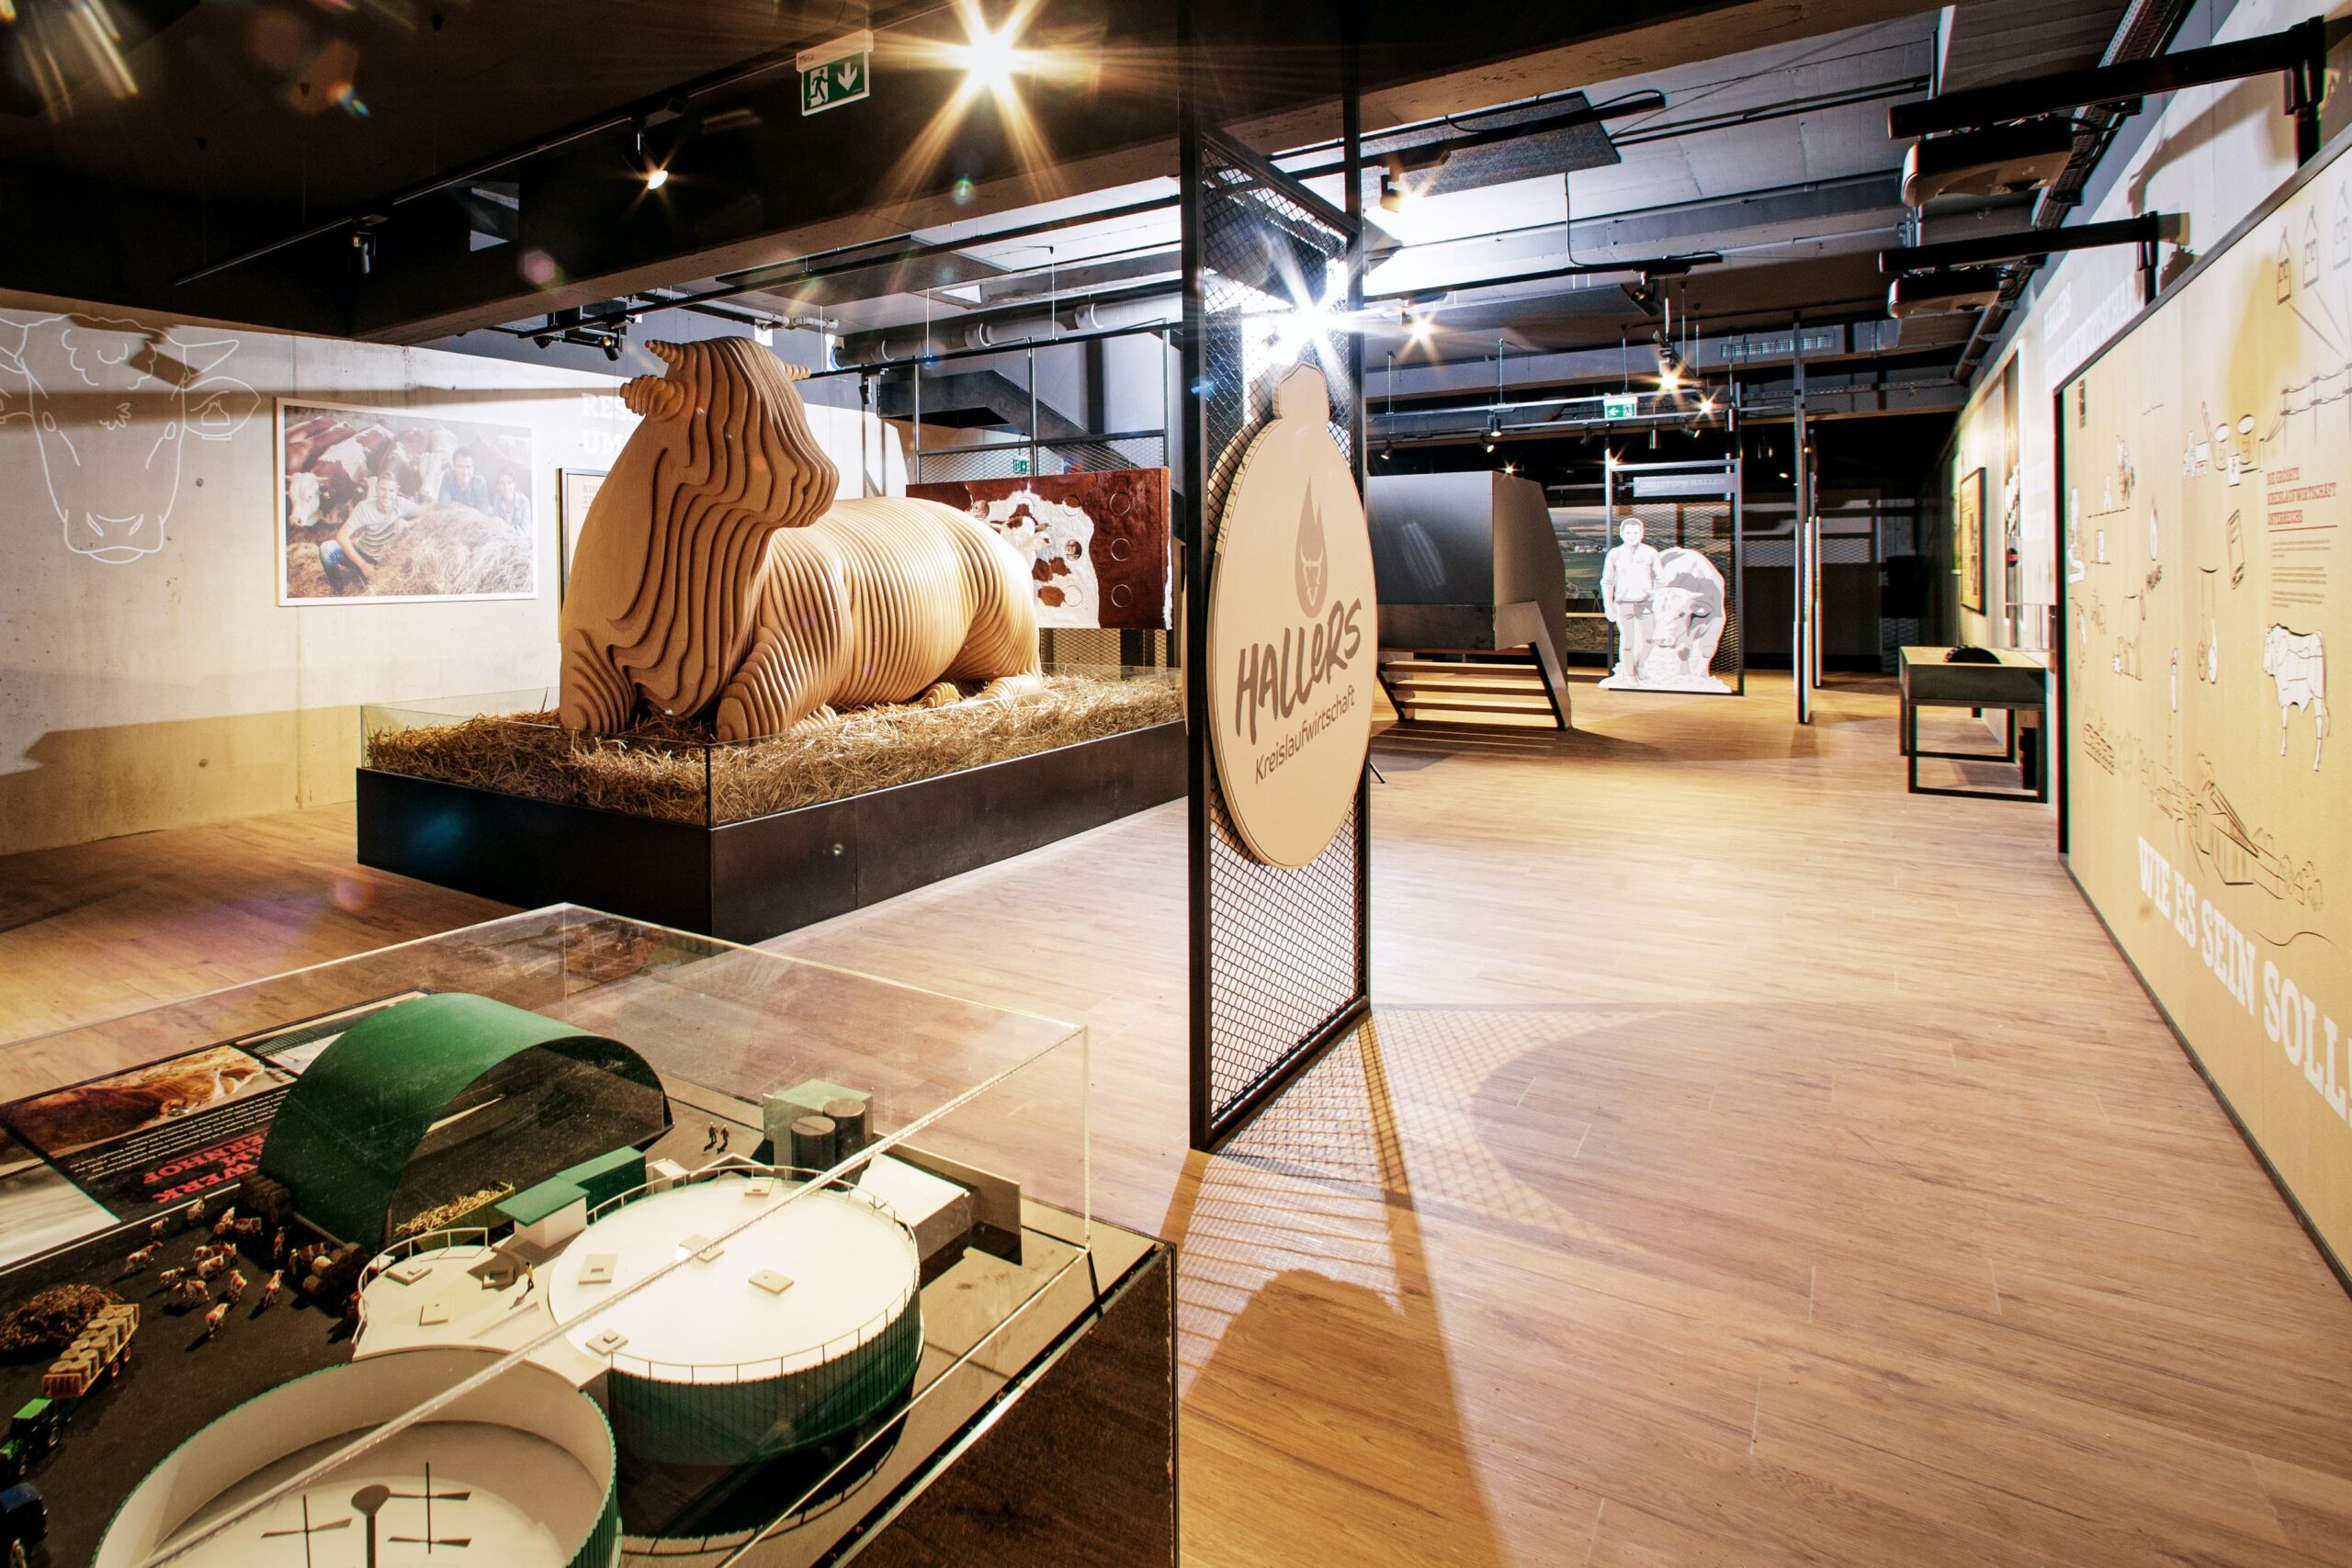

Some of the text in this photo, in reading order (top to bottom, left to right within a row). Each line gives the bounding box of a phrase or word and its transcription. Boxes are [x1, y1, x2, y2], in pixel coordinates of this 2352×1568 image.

[1254, 683, 1356, 784] Kreislaufwirtschaft
[2137, 834, 2171, 920] WIE
[2174, 870, 2197, 949] ES
[2200, 898, 2256, 1017] SEIN
[143, 1131, 267, 1185] ERNHOF
